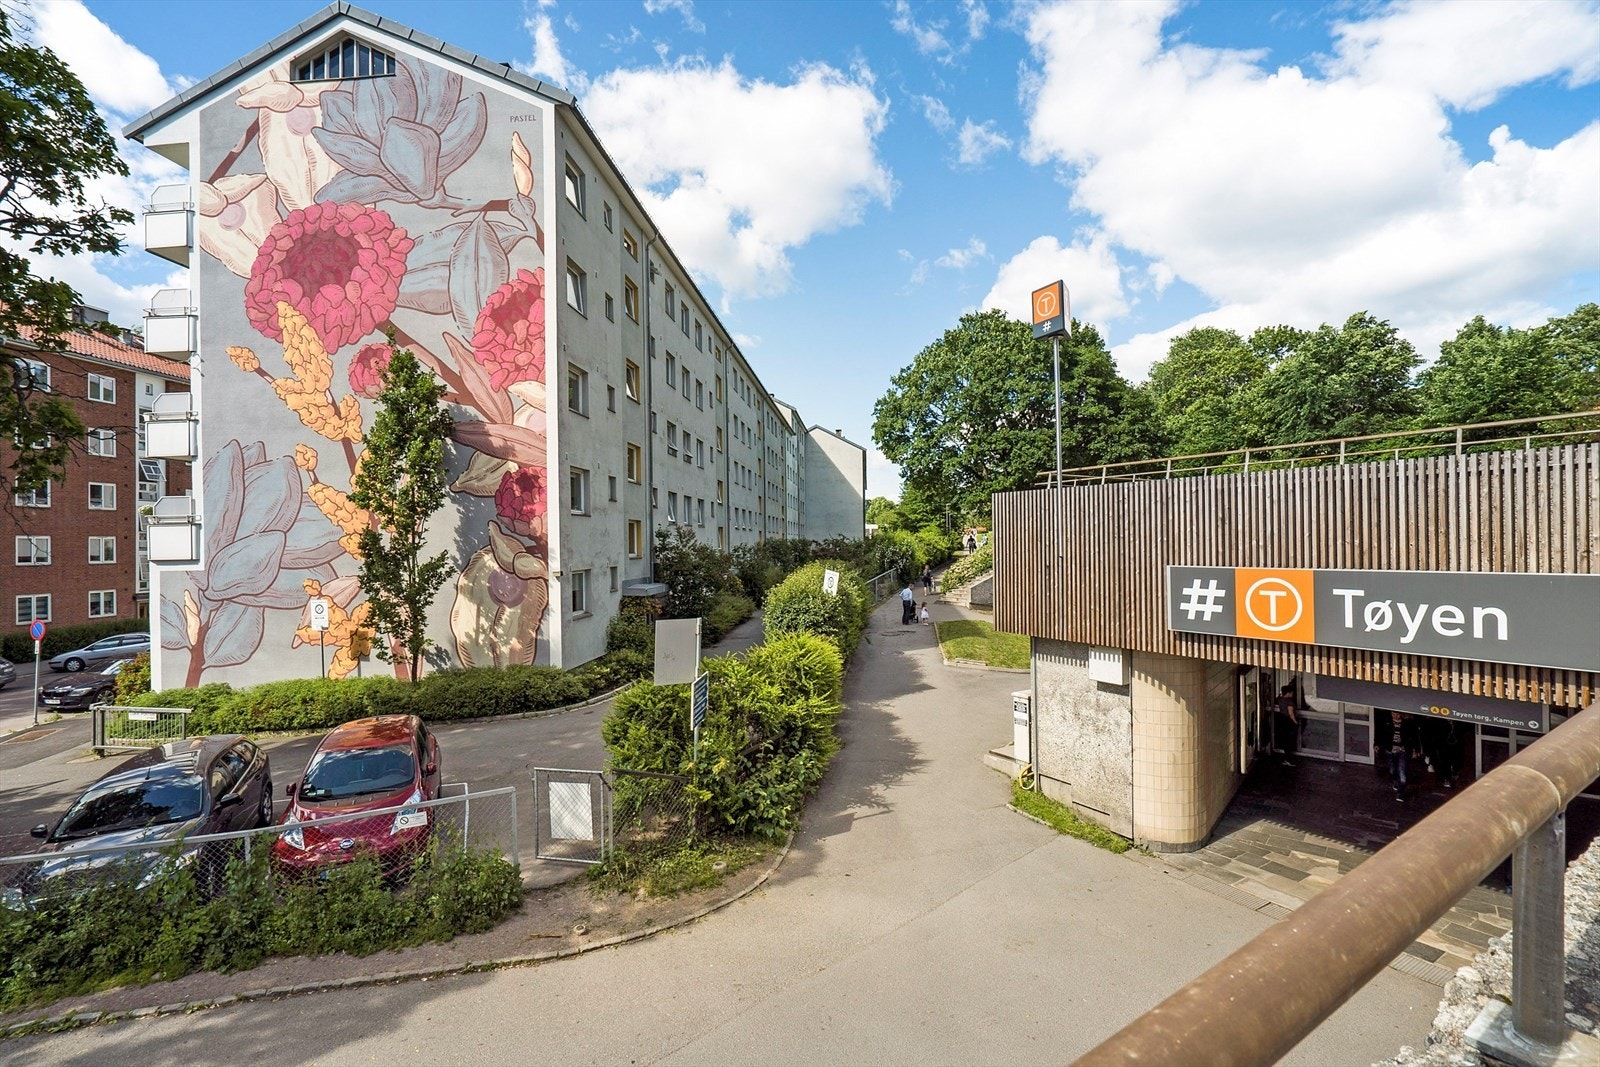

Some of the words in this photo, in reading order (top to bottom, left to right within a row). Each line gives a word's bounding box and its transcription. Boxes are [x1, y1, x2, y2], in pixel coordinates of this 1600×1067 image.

[510, 114, 536, 122] PASTEL
[1179, 578, 1227, 622] #
[1332, 588, 1509, 644] Tøyen
[1452, 710, 1473, 719] Tøyen
[1493, 716, 1524, 726] Kampen
